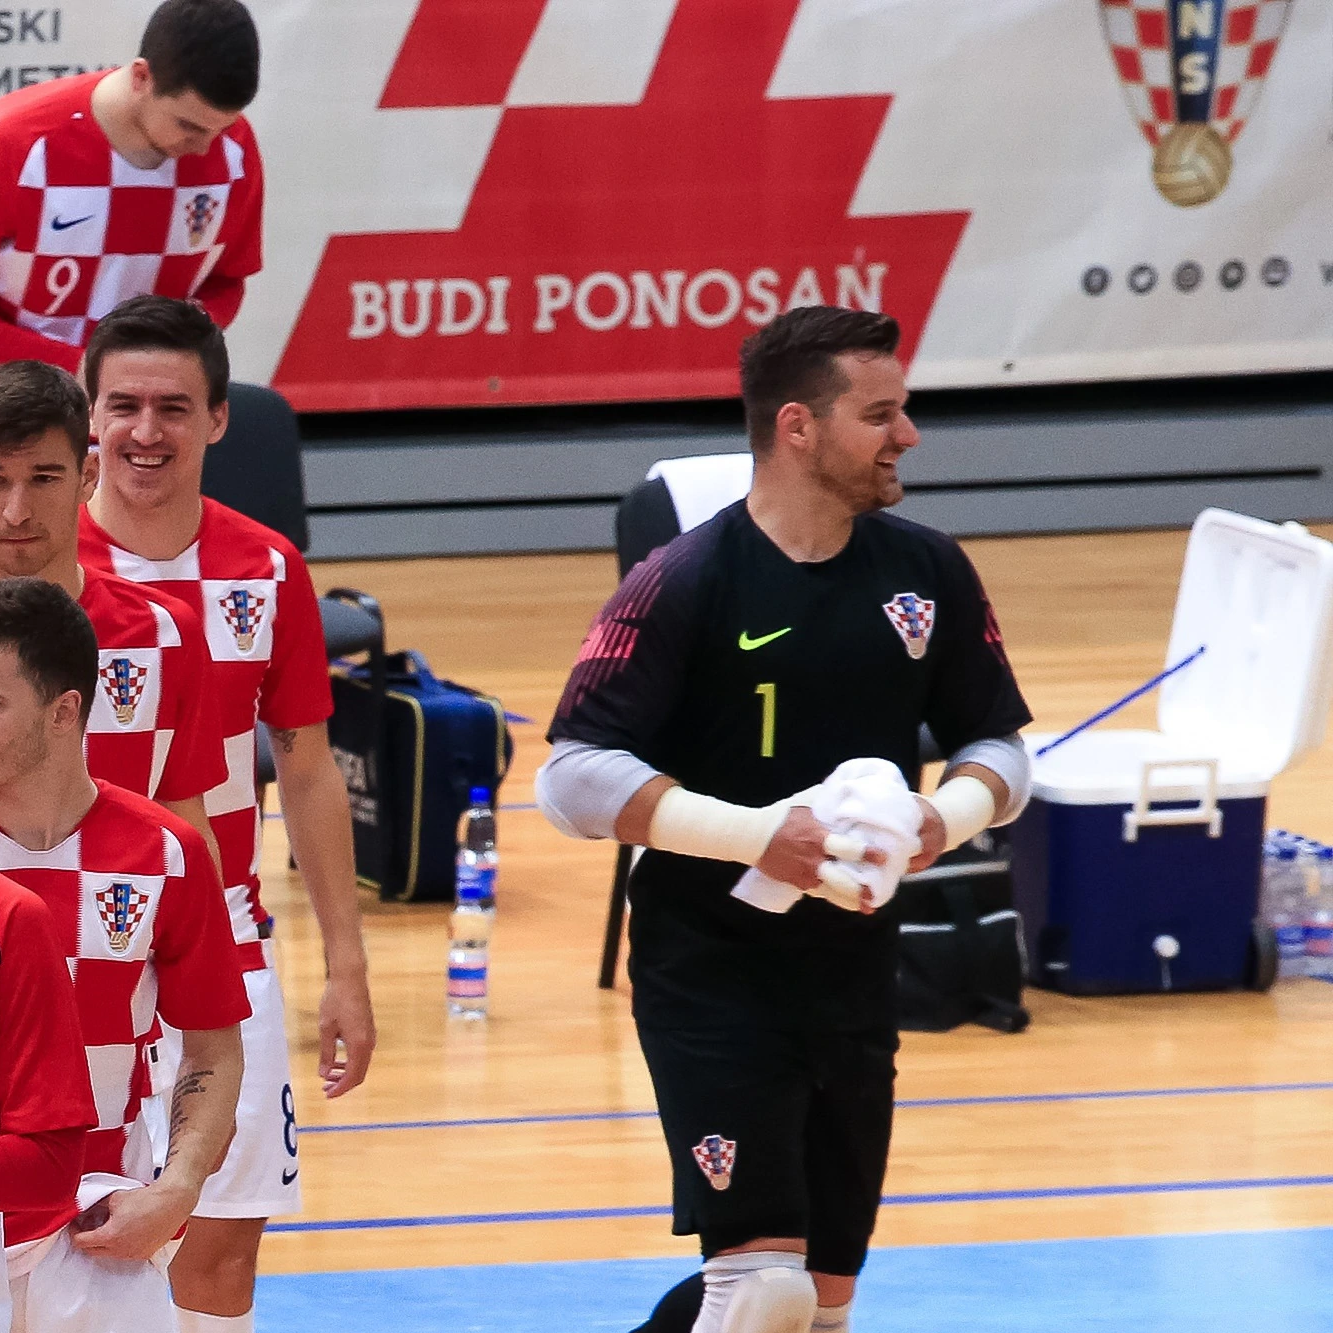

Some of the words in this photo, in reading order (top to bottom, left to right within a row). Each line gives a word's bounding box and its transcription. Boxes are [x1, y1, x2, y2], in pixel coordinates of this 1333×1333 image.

[42, 258, 78, 315] 9
[346, 276, 510, 340] BUDI
[756, 683, 776, 758] 1
[281, 1083, 297, 1158] 8
